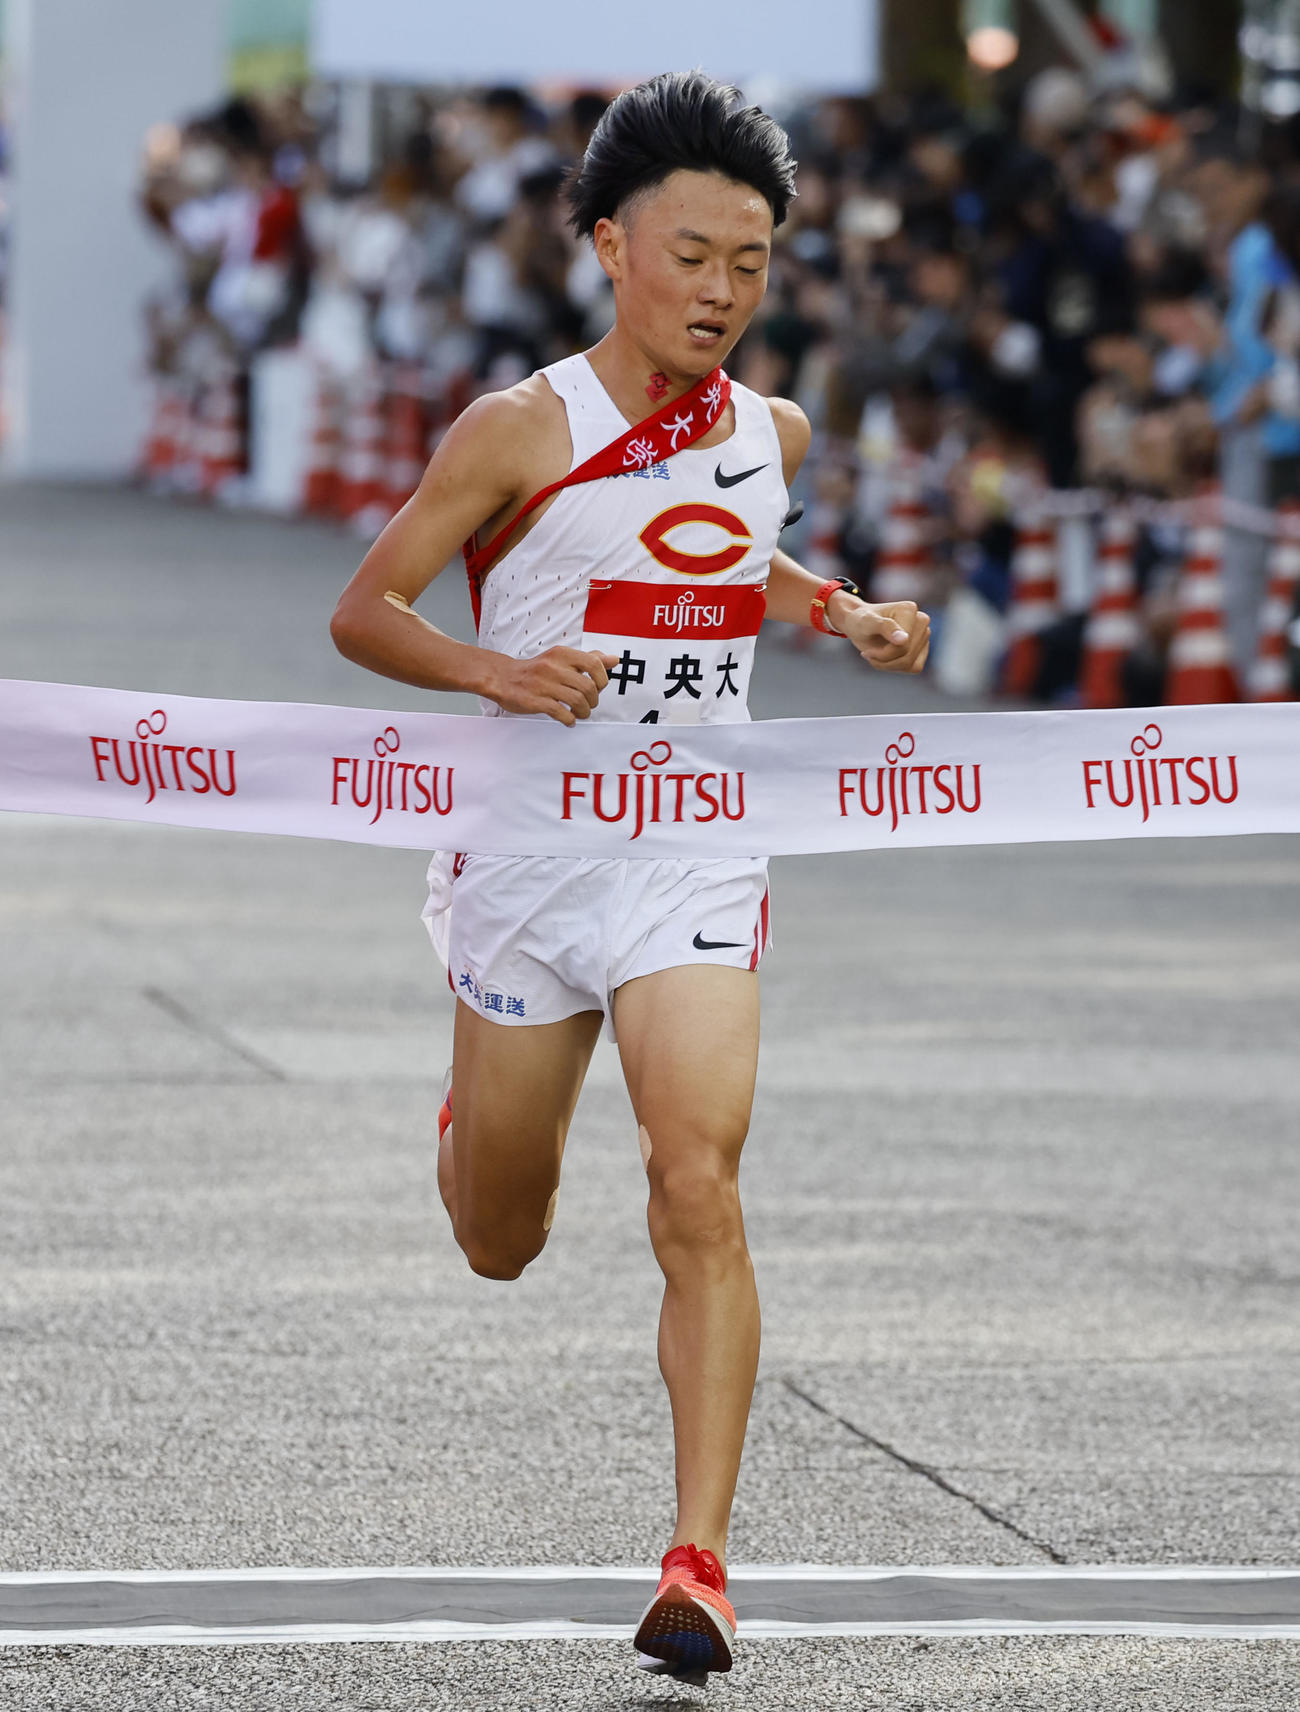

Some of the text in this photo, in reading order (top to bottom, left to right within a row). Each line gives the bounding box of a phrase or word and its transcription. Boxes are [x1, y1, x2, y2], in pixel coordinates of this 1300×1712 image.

[652, 591, 726, 633] FUJITSU
[607, 649, 740, 700] 中央大
[90, 709, 237, 804] FUJITSU
[331, 726, 455, 825] FUJITSU
[561, 740, 745, 841] FUJITSU
[839, 731, 982, 832] FUJITSU
[1082, 723, 1239, 823] FUJITSU
